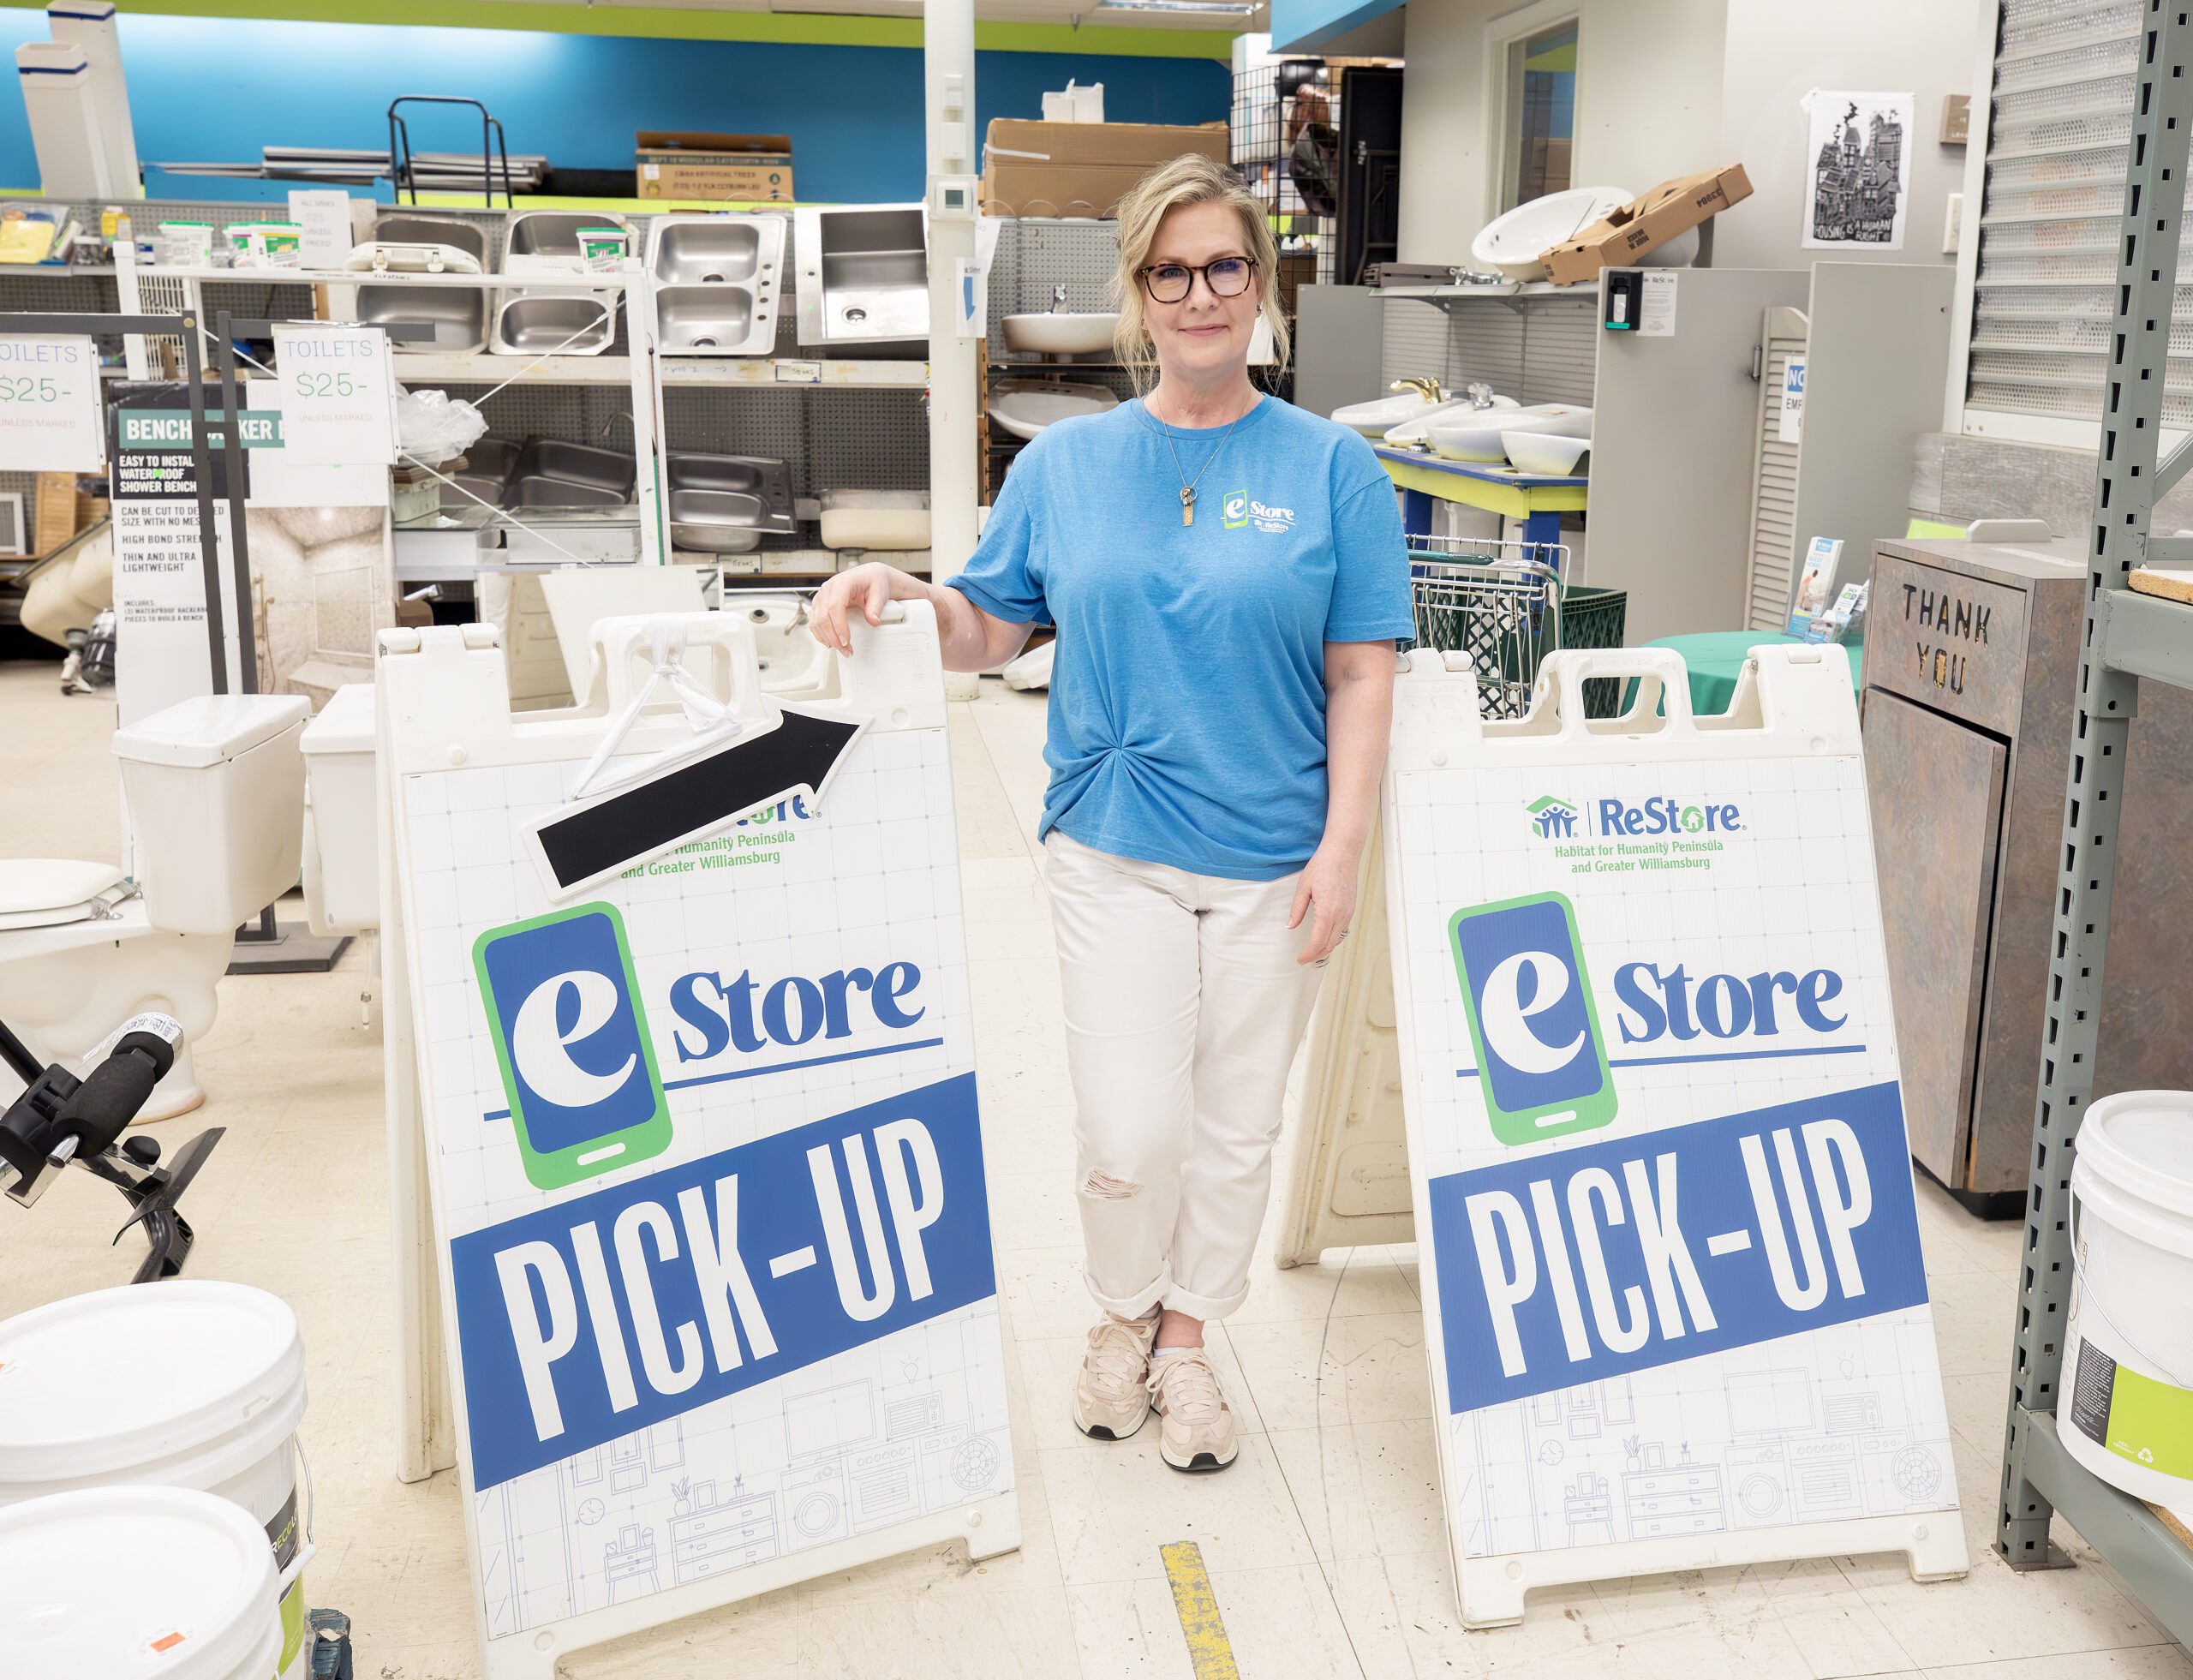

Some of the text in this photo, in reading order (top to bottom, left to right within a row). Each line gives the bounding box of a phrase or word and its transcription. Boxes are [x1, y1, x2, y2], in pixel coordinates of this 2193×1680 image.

[1847, 223, 1854, 234] IS
[1855, 220, 1861, 230] A
[1861, 218, 1891, 230] HUMAN
[1855, 230, 1883, 242] RIGHT
[0, 344, 78, 363] OILETS
[284, 340, 373, 358] TOILETS
[36, 419, 75, 428] MARKED
[299, 413, 372, 422] UNLESS MARKED
[126, 418, 193, 440] BENCH
[119, 455, 144, 468] EASY
[146, 456, 159, 468] TO
[119, 469, 185, 481] WATERROOF
[120, 480, 197, 493] SHOWER BENCH
[121, 506, 139, 516] CAN
[141, 506, 152, 516] BE
[155, 506, 172, 516] CUT
[174, 506, 185, 516] TO
[1251, 500, 1294, 521] Store
[122, 517, 140, 527] SIZE
[144, 517, 165, 526] WITH
[168, 517, 180, 526] NO
[122, 535, 145, 544] HIGH
[147, 535, 173, 544] BOND
[122, 553, 196, 561] THIN AND ULTRA
[122, 563, 185, 572] LIGHTWEIGHT
[1903, 583, 1991, 649] THANK
[1917, 642, 1966, 695] YOU
[1598, 797, 1742, 836] ReStore
[738, 830, 796, 848] Peninsula
[1555, 840, 1724, 858] Habitat for Humanity Peninsula
[621, 850, 780, 879] and Greater Williamsburg
[1571, 857, 1711, 873] and Greater Williamsburg
[1481, 951, 1849, 1073] e Store
[513, 960, 926, 1108] e Store
[1464, 1118, 1873, 1378] PICK-UP
[493, 1118, 944, 1443] PICK-UP
